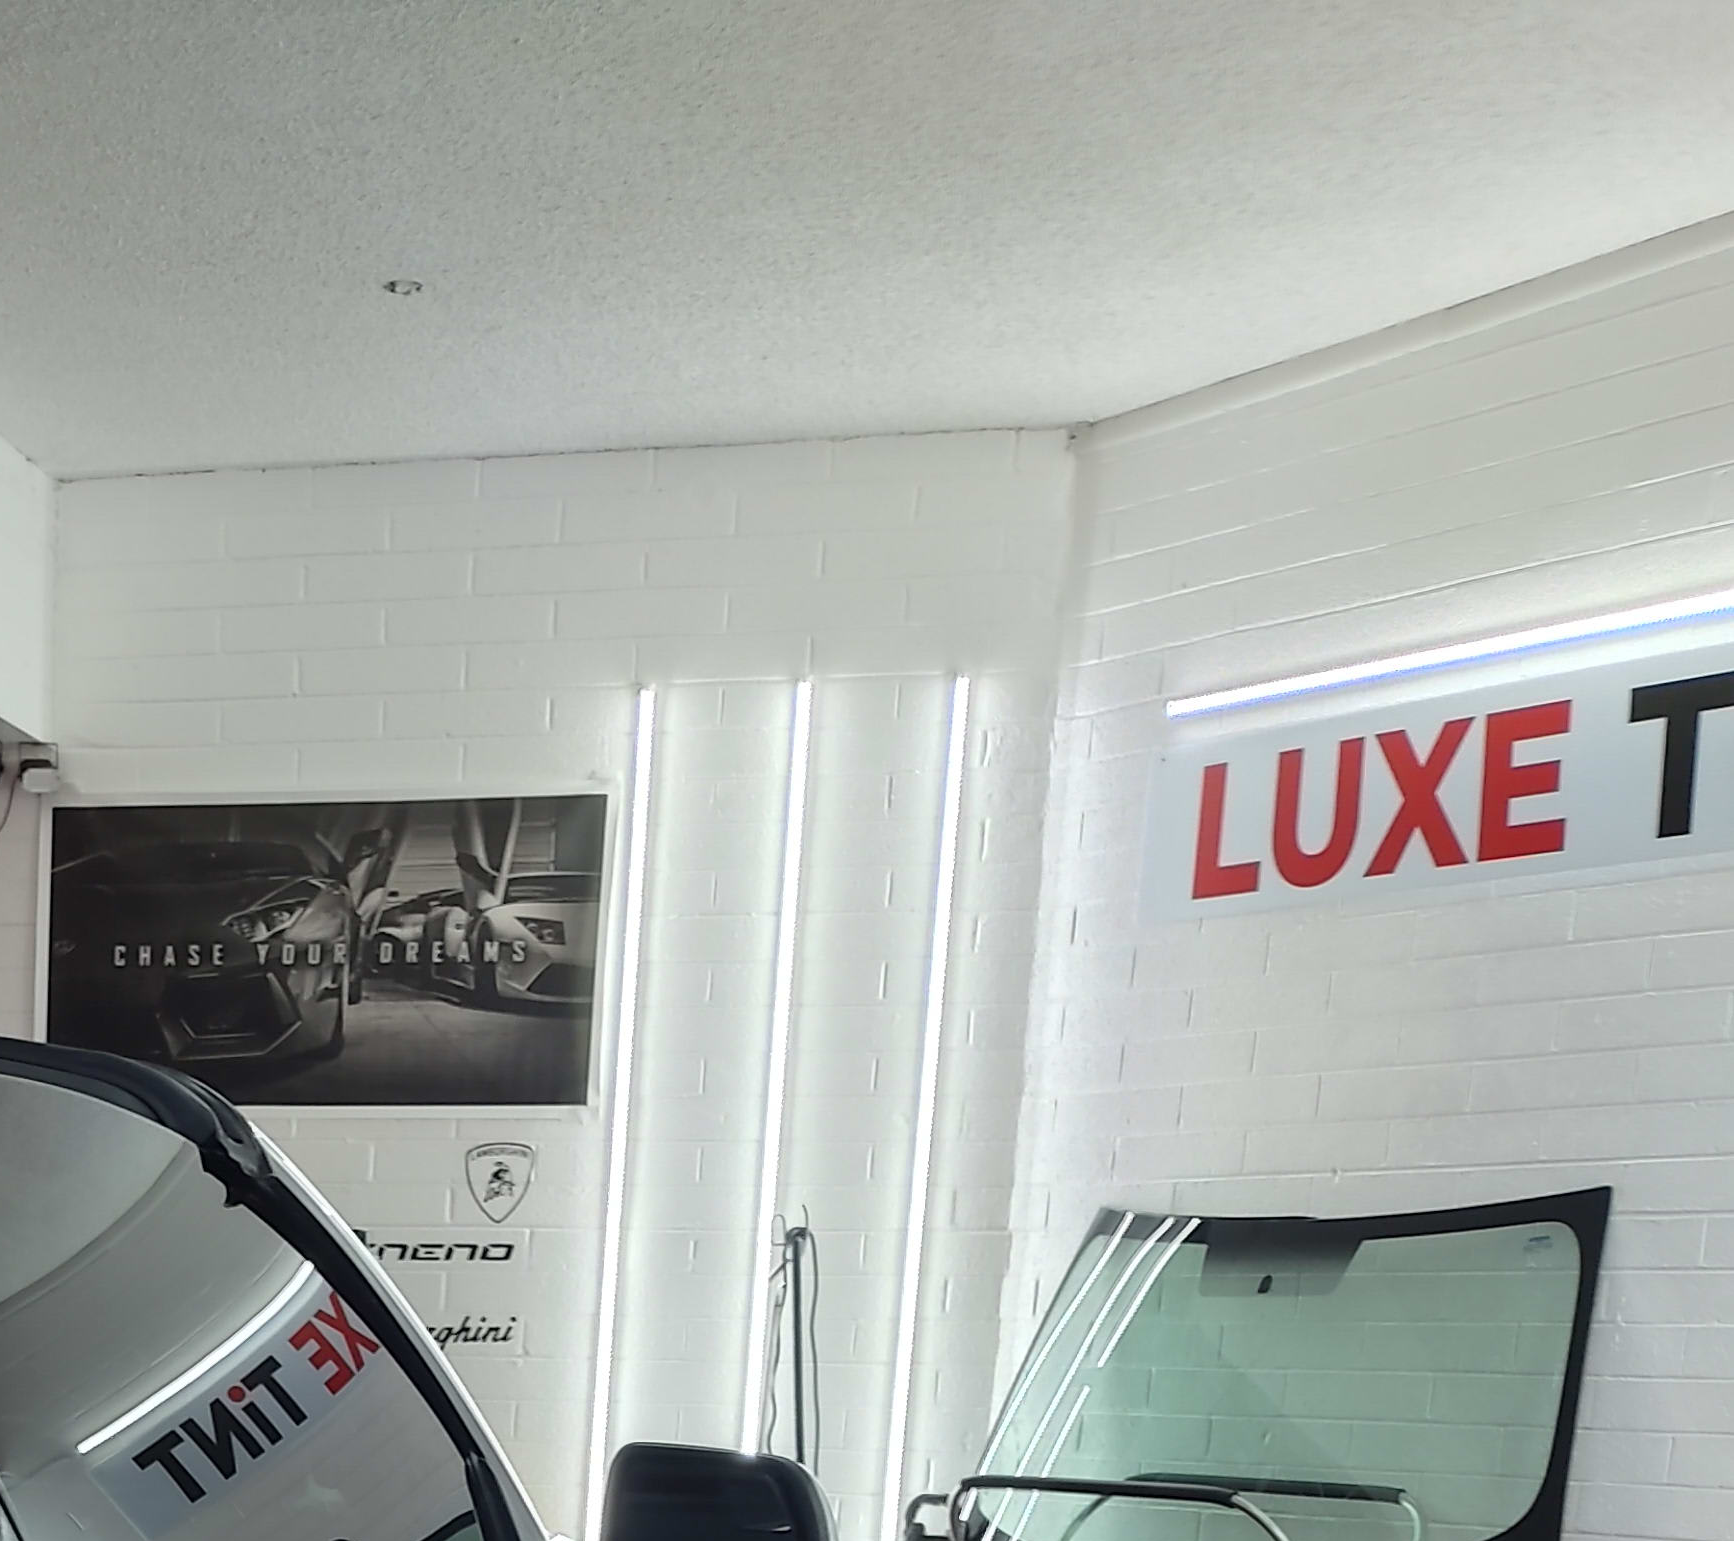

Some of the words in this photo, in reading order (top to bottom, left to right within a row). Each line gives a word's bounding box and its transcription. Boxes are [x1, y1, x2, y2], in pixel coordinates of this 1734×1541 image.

[1192, 699, 1572, 899] LUXE
[113, 943, 225, 968] CHASE
[257, 942, 348, 967] YOUR
[379, 939, 528, 964] DREAMS
